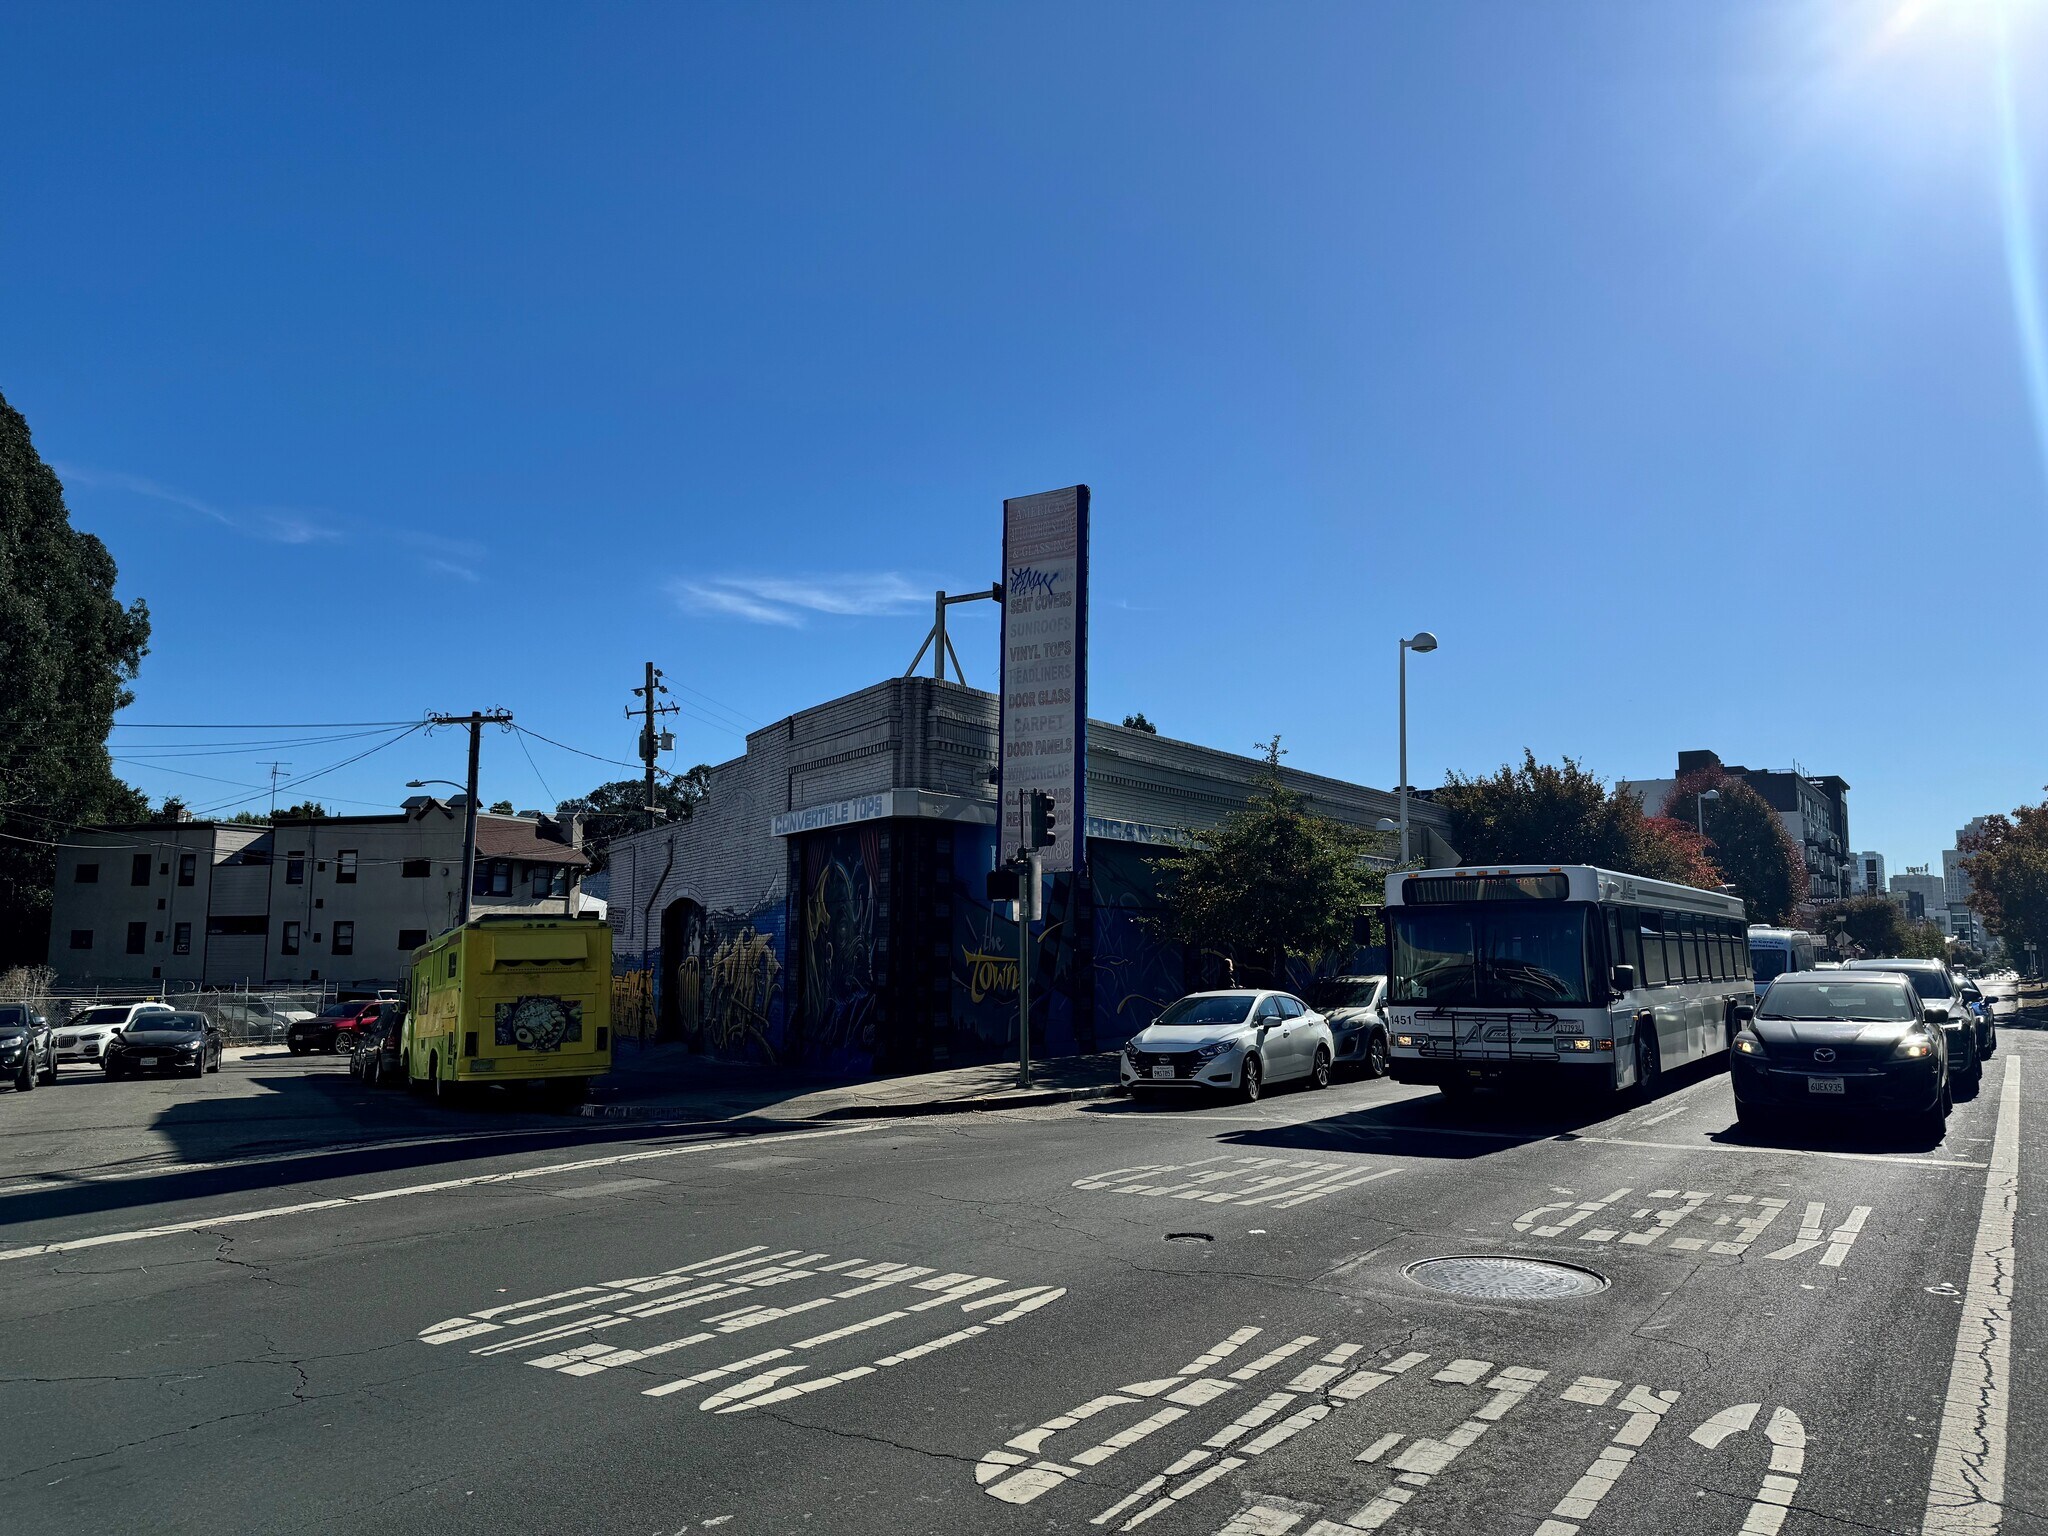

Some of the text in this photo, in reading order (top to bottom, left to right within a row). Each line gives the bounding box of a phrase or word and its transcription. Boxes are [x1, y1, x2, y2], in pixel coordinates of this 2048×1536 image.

[1015, 502, 1068, 521] AMERICAN
[1012, 547, 1019, 559] &
[1022, 542, 1051, 557] GLASS
[1010, 591, 1072, 615] SEAT COVERS
[1010, 617, 1072, 639] SUNROOFS
[1009, 640, 1072, 663] VINYL TOPS
[1009, 664, 1072, 686] HEADLINERS
[1008, 687, 1072, 709] DOOR GLASS
[1014, 714, 1065, 733] CARPET
[1006, 737, 1073, 758] DOOR PANELS
[1007, 763, 1071, 782] WINDSHIELDS
[774, 795, 883, 834] CONVERTIBLE TOPS
[1088, 816, 1152, 842] RICAN
[1418, 988, 1425, 997] 2
[1390, 1015, 1412, 1025] 1451
[1811, 1083, 1843, 1092] 6UEK935
[1511, 1187, 1873, 1268] KEEP
